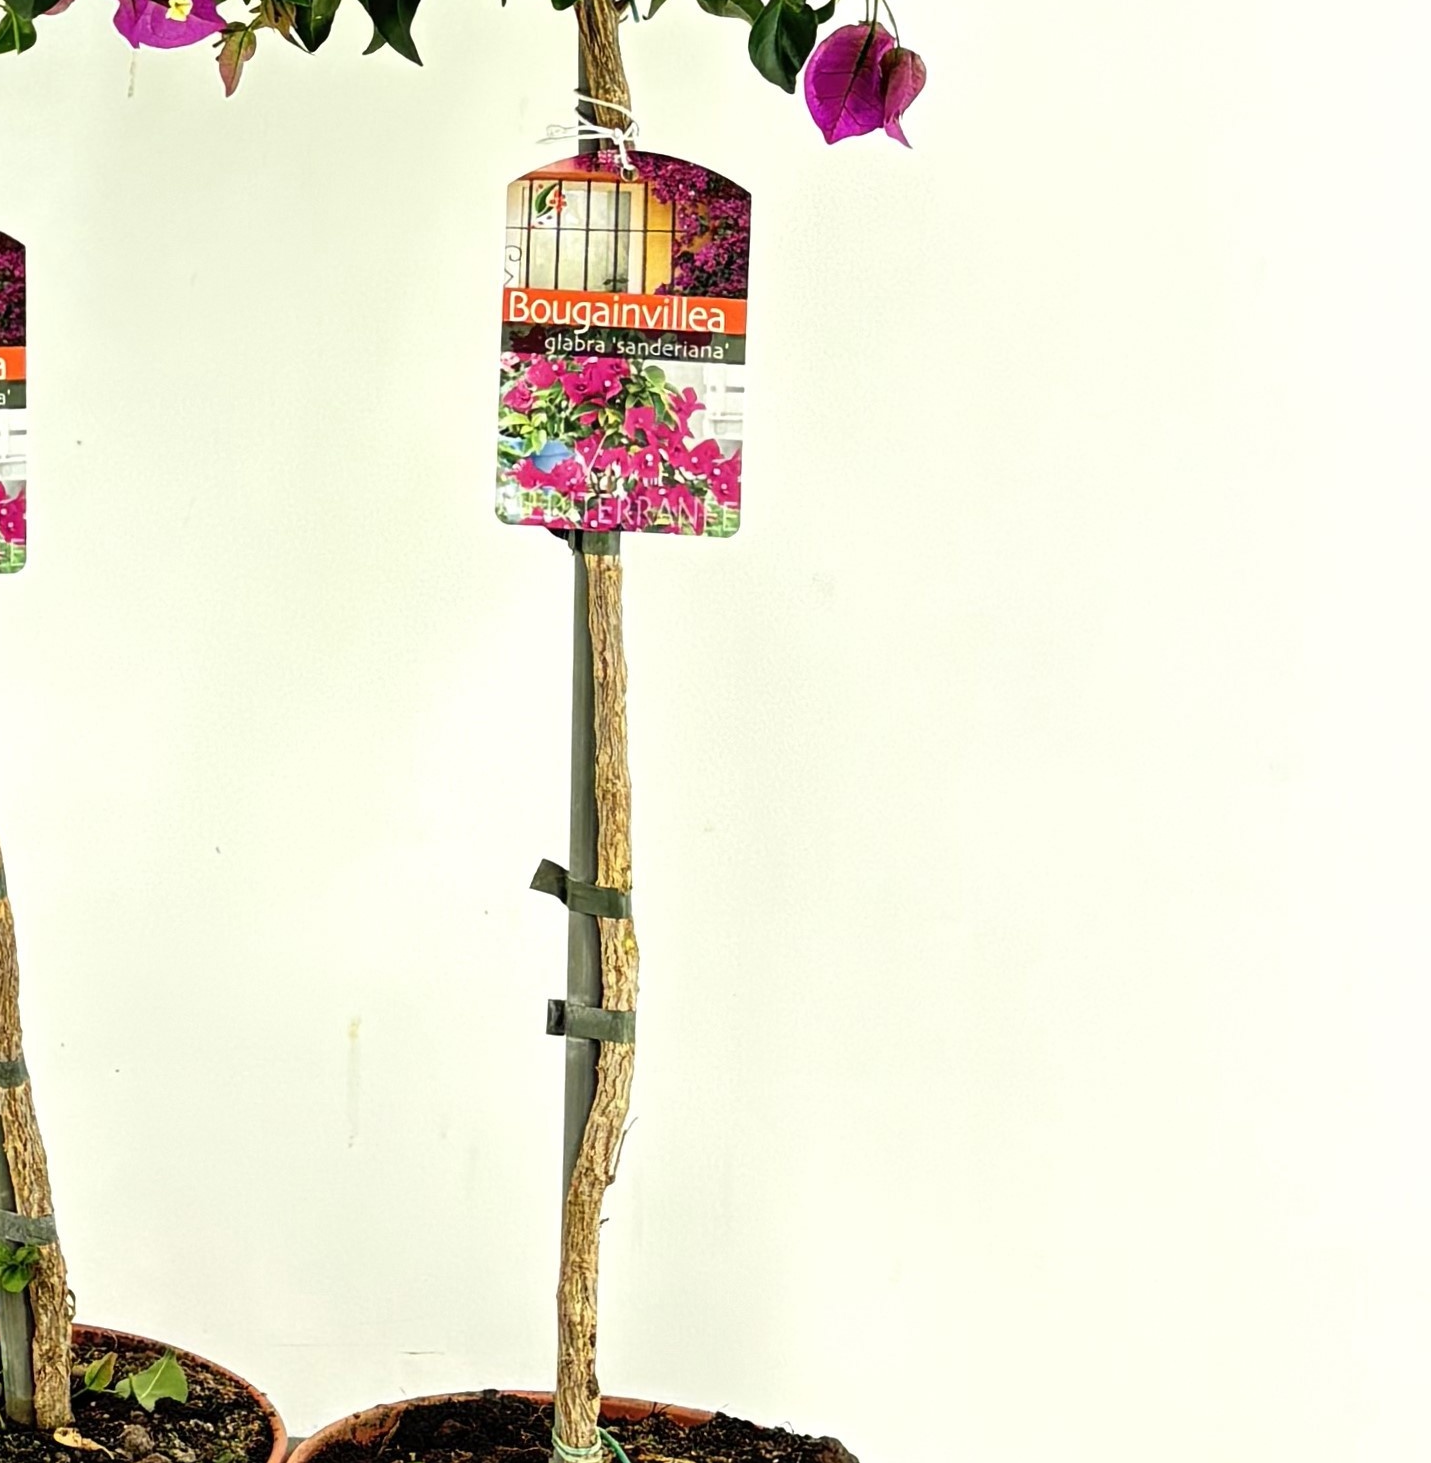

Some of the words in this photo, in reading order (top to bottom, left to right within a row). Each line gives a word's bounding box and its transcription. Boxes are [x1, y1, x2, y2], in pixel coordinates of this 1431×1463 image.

[509, 290, 725, 335] Bougainvillea
[544, 334, 605, 354] glabra
[612, 337, 729, 360] 'sanderiana'
